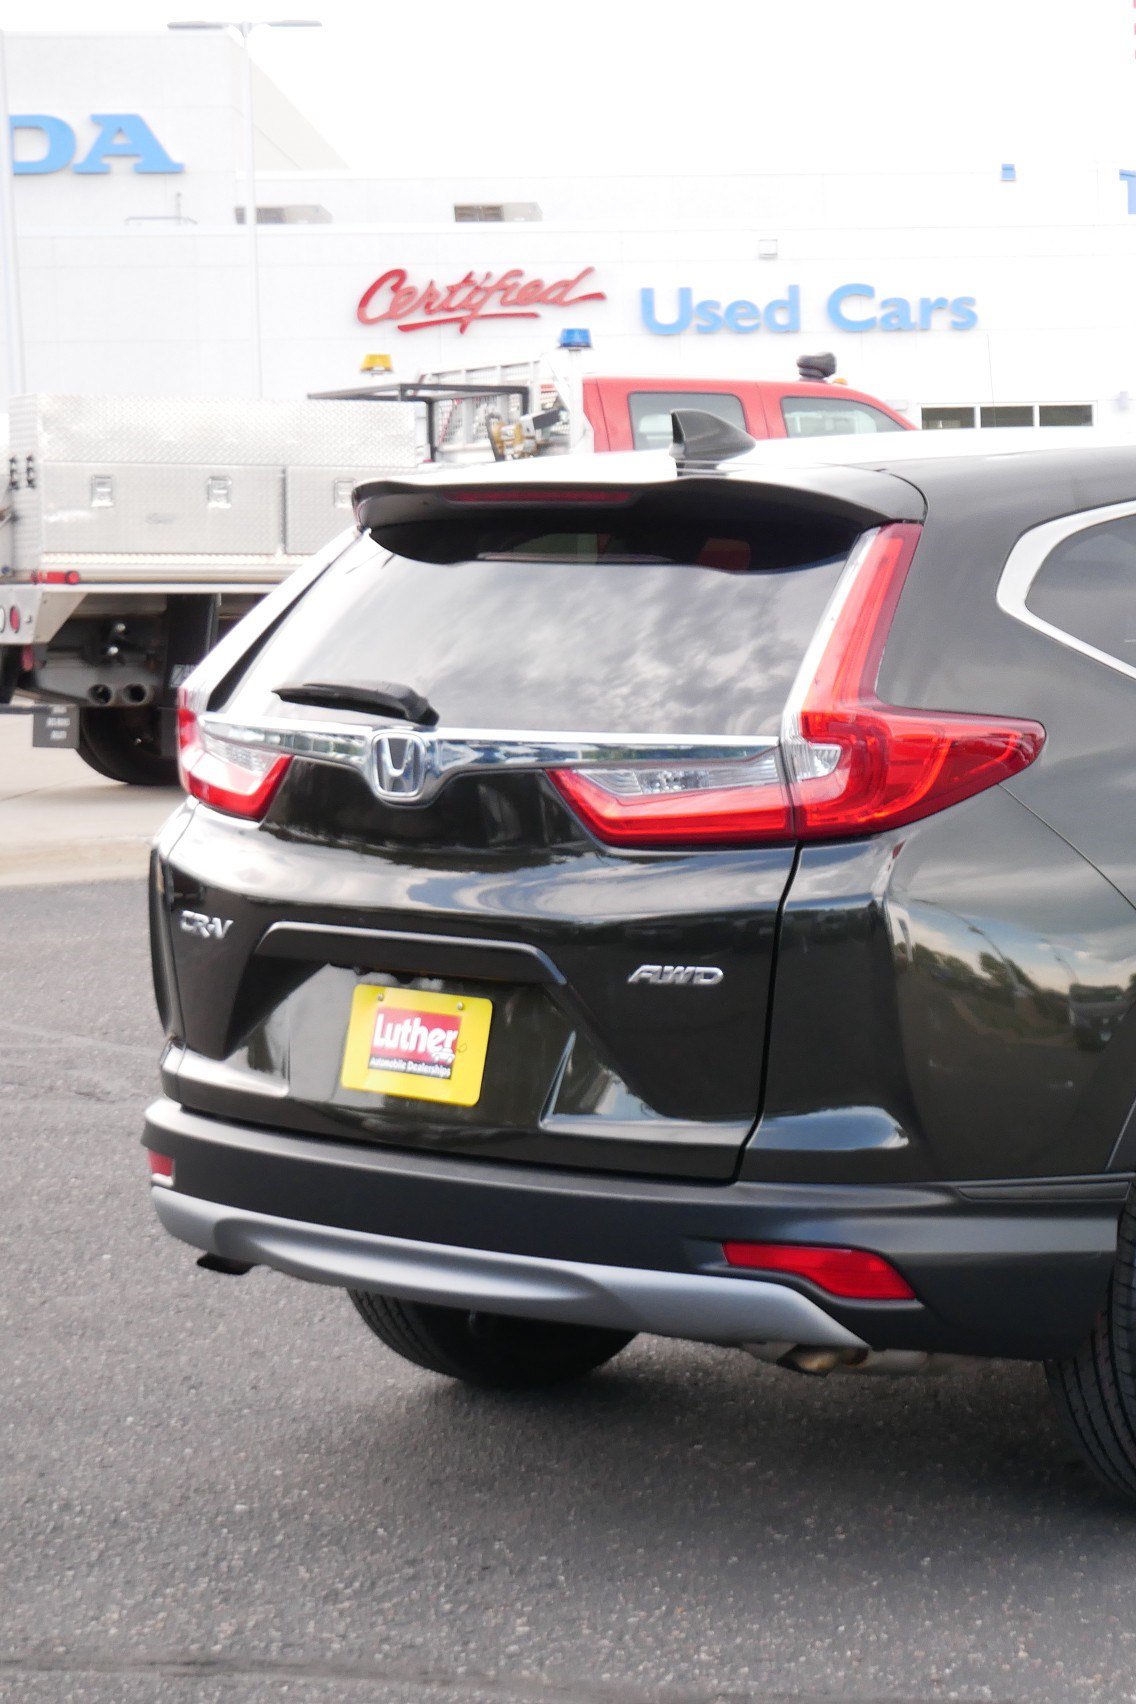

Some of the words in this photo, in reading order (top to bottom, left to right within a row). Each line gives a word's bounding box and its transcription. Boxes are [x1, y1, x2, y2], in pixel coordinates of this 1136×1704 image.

[357, 266, 606, 334] Certified
[640, 284, 800, 335] Used
[826, 282, 979, 332] Cars
[627, 964, 724, 985] AWD
[373, 1013, 459, 1054] Luther
